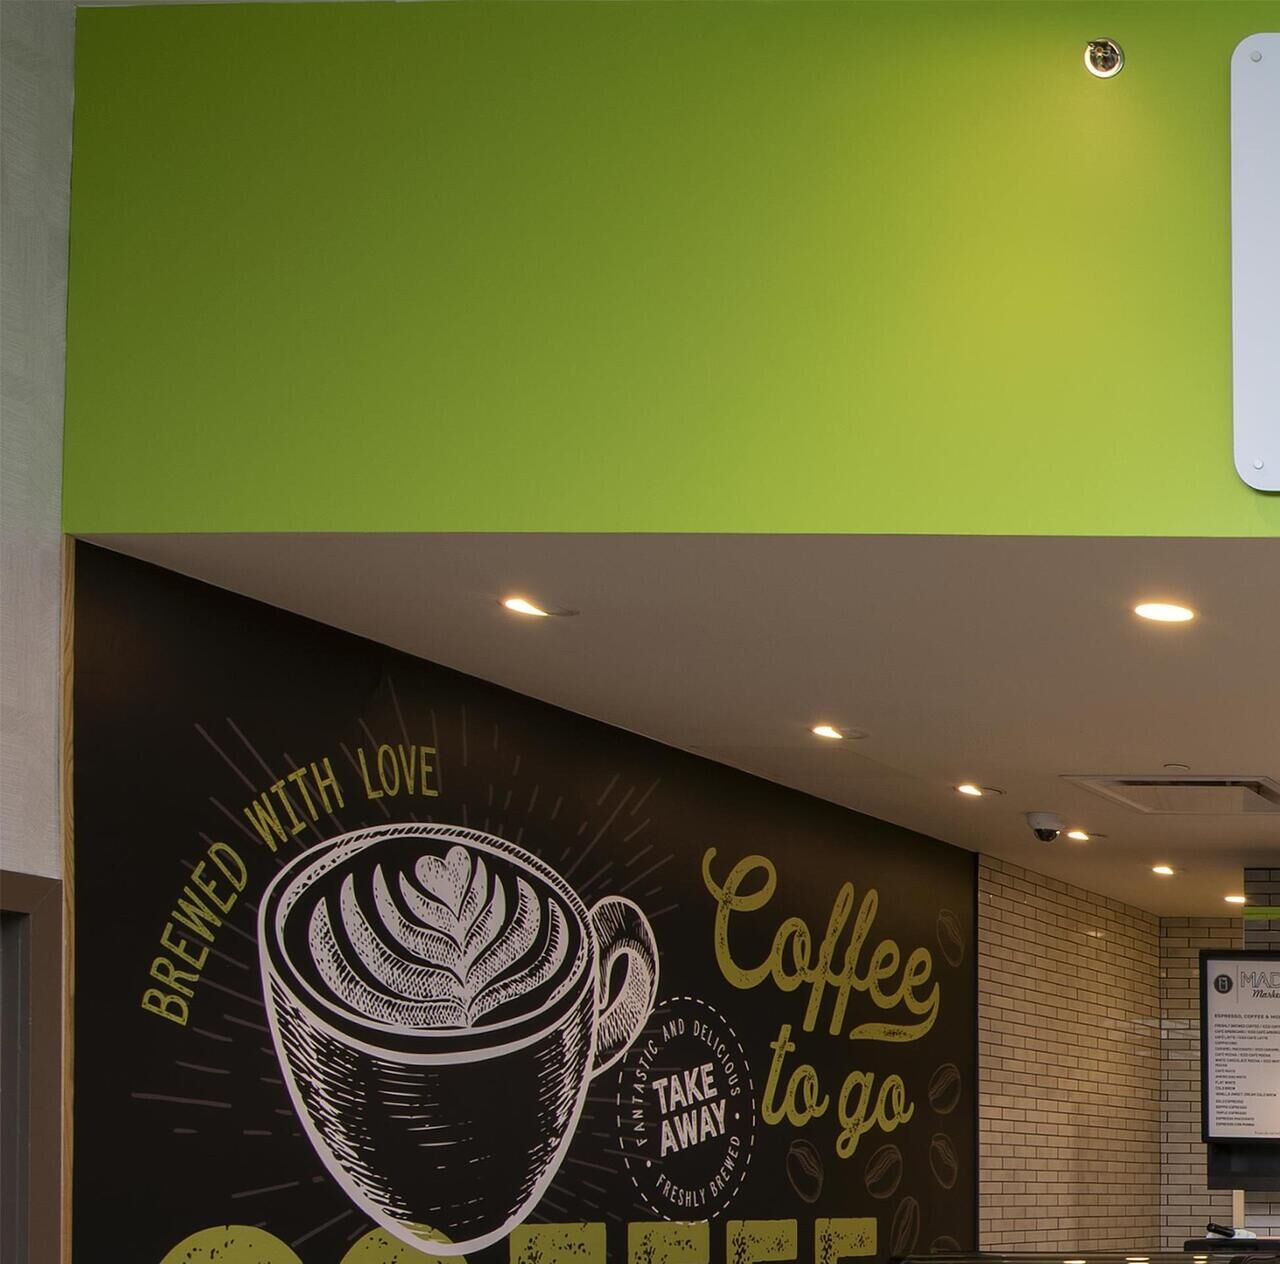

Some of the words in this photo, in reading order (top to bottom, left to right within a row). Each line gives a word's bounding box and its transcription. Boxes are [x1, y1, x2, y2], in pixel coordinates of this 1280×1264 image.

[142, 842, 249, 1026] BREWED
[243, 757, 345, 852] WITH
[358, 743, 440, 800] LOVE
[703, 847, 941, 1046] Coffee
[632, 1039, 659, 1148] FANTASTIC
[662, 1018, 685, 1042] AND
[693, 1020, 741, 1096] DELICIOUS
[652, 1062, 718, 1115] TAKE
[660, 1099, 726, 1158] AWAY
[761, 1014, 830, 1127] to
[836, 1071, 916, 1160] go
[655, 1172, 706, 1208] FRESHLY
[709, 1136, 740, 1197] BREWED
